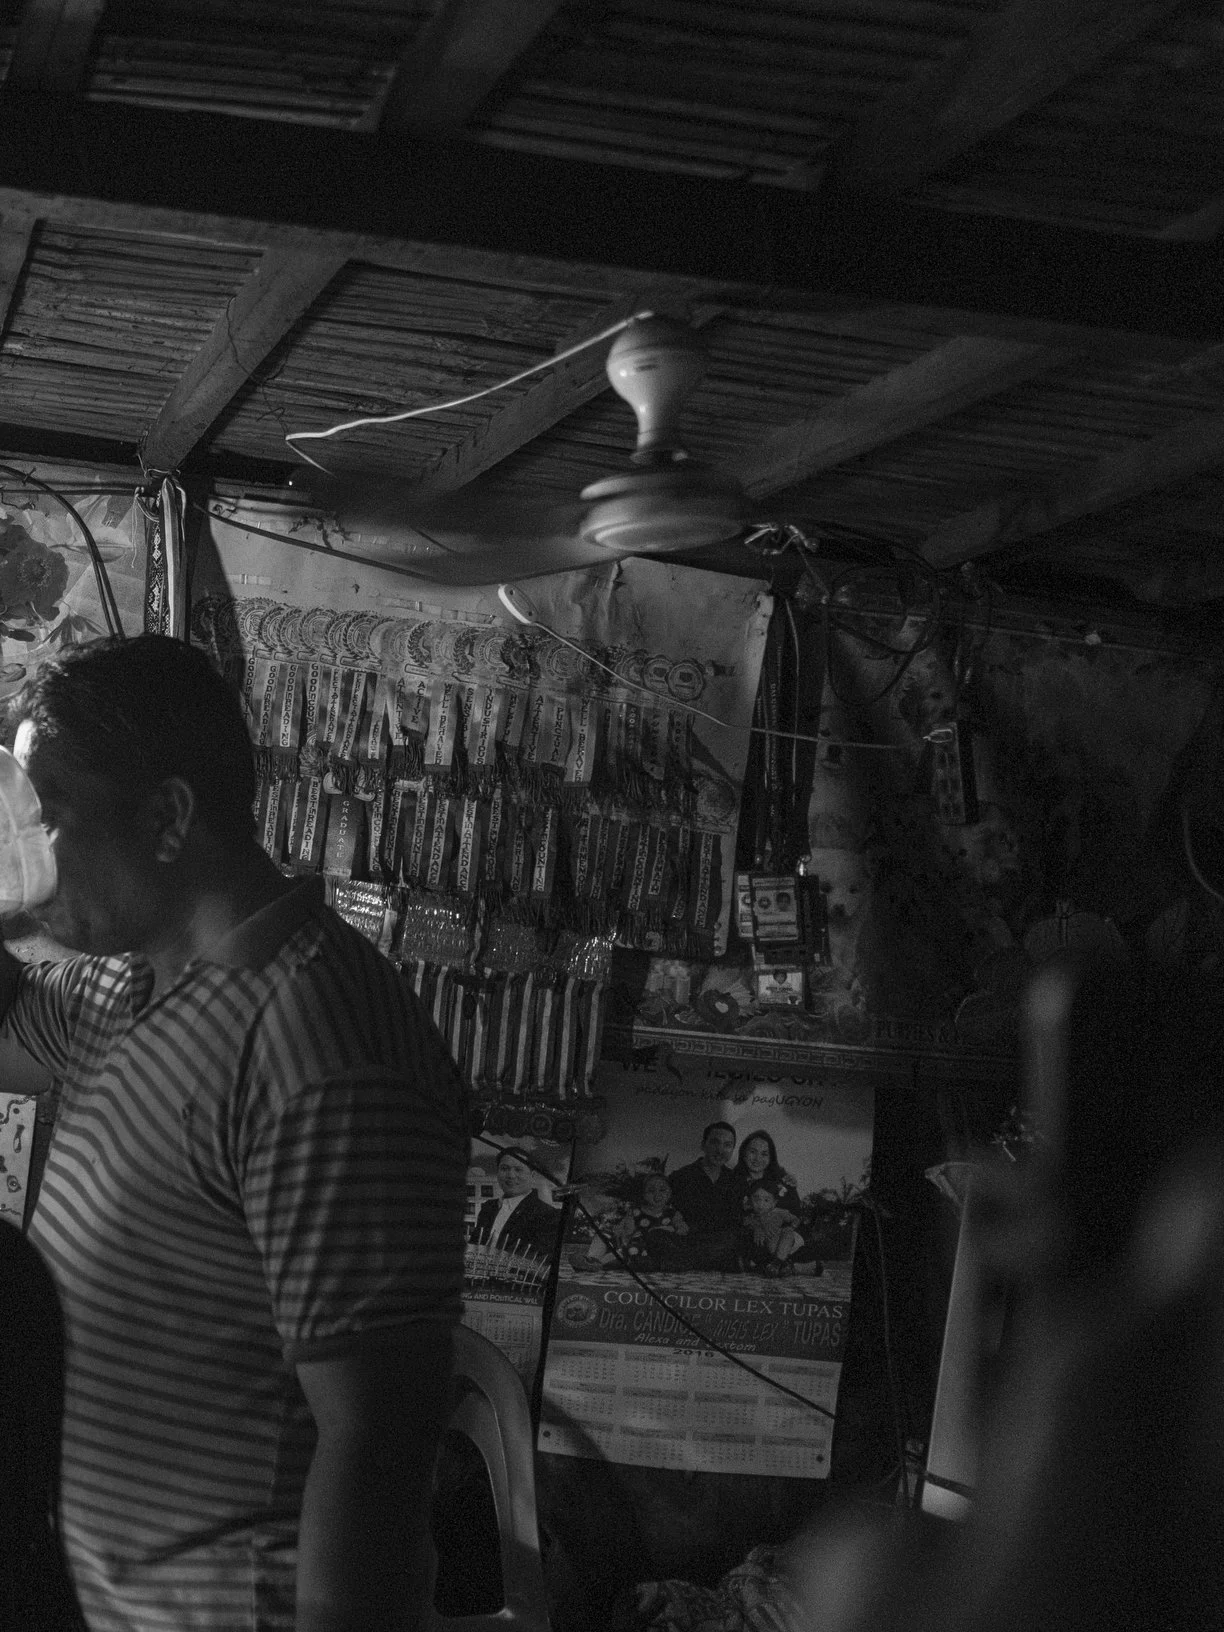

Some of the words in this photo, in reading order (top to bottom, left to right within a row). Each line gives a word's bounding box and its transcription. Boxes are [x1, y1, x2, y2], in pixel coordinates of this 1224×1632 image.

[336, 800, 350, 858] GRADUATE
[604, 1290, 726, 1312] COUNCILOR
[734, 1298, 774, 1314] LEX
[779, 1301, 843, 1319] TUPAS
[599, 1308, 627, 1330] Dra.
[794, 1320, 842, 1347] TUPAS
[634, 1333, 670, 1345] Alexa
[676, 1336, 700, 1346] and
